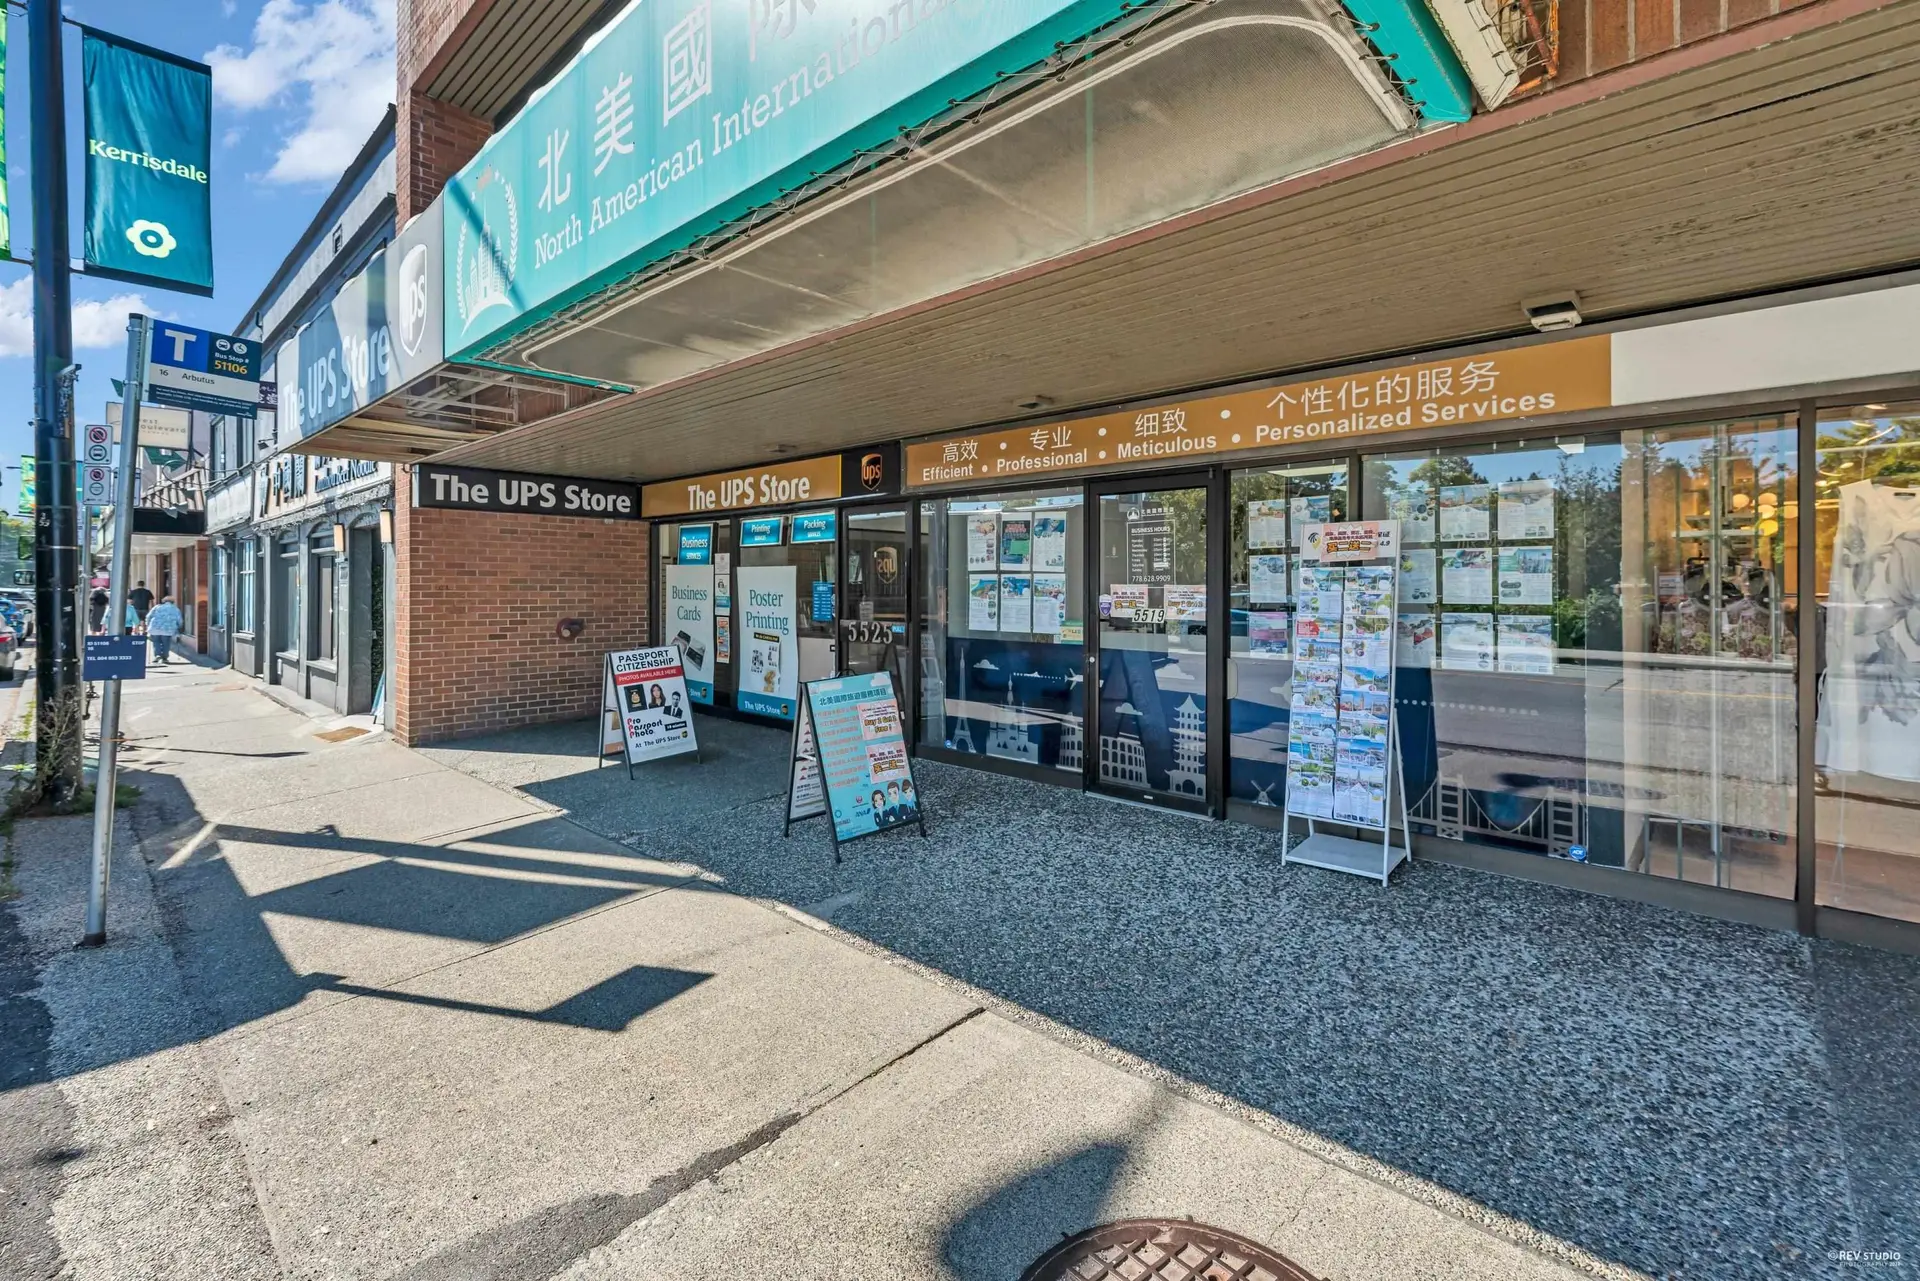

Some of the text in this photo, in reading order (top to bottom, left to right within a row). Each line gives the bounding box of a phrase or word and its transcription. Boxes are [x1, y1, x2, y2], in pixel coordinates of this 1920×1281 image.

[89, 139, 208, 185] Kerrisdale
[534, 211, 583, 270] North
[588, 139, 701, 236] American
[165, 329, 197, 362] T
[214, 352, 228, 360] Bus
[228, 354, 244, 364] Stop
[214, 360, 248, 375] 51106
[159, 368, 216, 385] 16 Arbutus
[283, 325, 390, 433] The UPS Store
[942, 361, 1500, 464] 高效 专业 细致 个性化的服务
[140, 424, 187, 434] oulevard
[922, 392, 1556, 482] Efficient Professional Meticulous Personalized Services
[862, 462, 881, 482] ups
[430, 473, 632, 513] The UPS Store
[687, 474, 811, 511] The UPS Store
[751, 523, 771, 534] Printing
[803, 520, 826, 530] Packing
[681, 536, 708, 548] Business
[672, 585, 708, 601] Business
[749, 589, 782, 607] Poster
[676, 605, 702, 621] Cards
[1133, 609, 1165, 622] 5519
[745, 611, 790, 636] Printing
[848, 622, 893, 644] 5525
[618, 650, 670, 663] PASSPORT
[616, 657, 674, 673] CITIZENSHIP
[619, 673, 640, 682] PHOTOS
[639, 670, 665, 680] AVAILABLE
[744, 700, 781, 715] The UPS Store
[627, 717, 641, 726] Pro
[628, 719, 663, 732] Passport
[629, 728, 654, 739] Photo
[667, 735, 681, 743] Store
